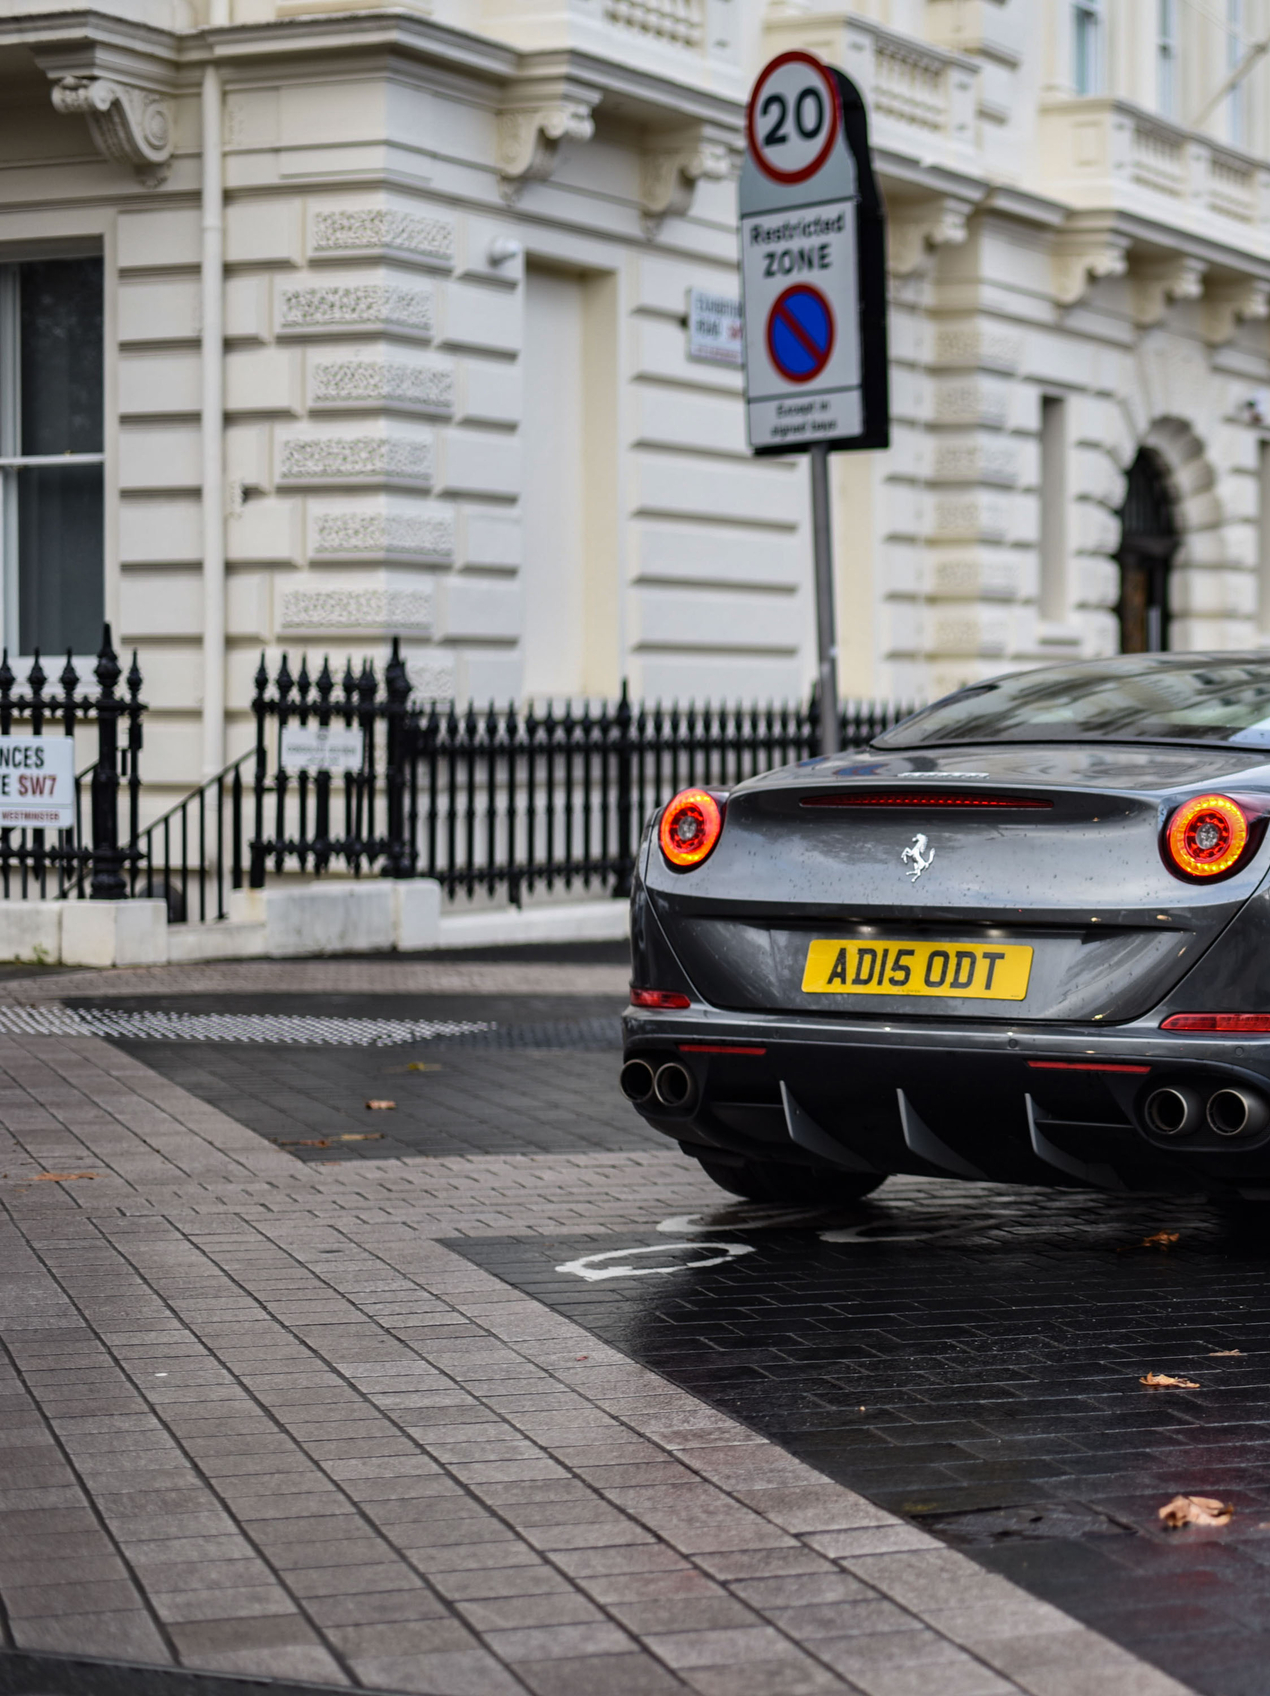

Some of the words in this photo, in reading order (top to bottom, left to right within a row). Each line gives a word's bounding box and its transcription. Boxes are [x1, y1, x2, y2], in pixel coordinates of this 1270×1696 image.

[759, 86, 823, 147] 20
[750, 211, 845, 246] Restricted
[763, 242, 832, 278] ZONE
[18, 774, 56, 796] SW7
[2, 809, 59, 823] WESTMINSTER
[826, 947, 915, 987] AD15
[924, 949, 1006, 991] ODT
